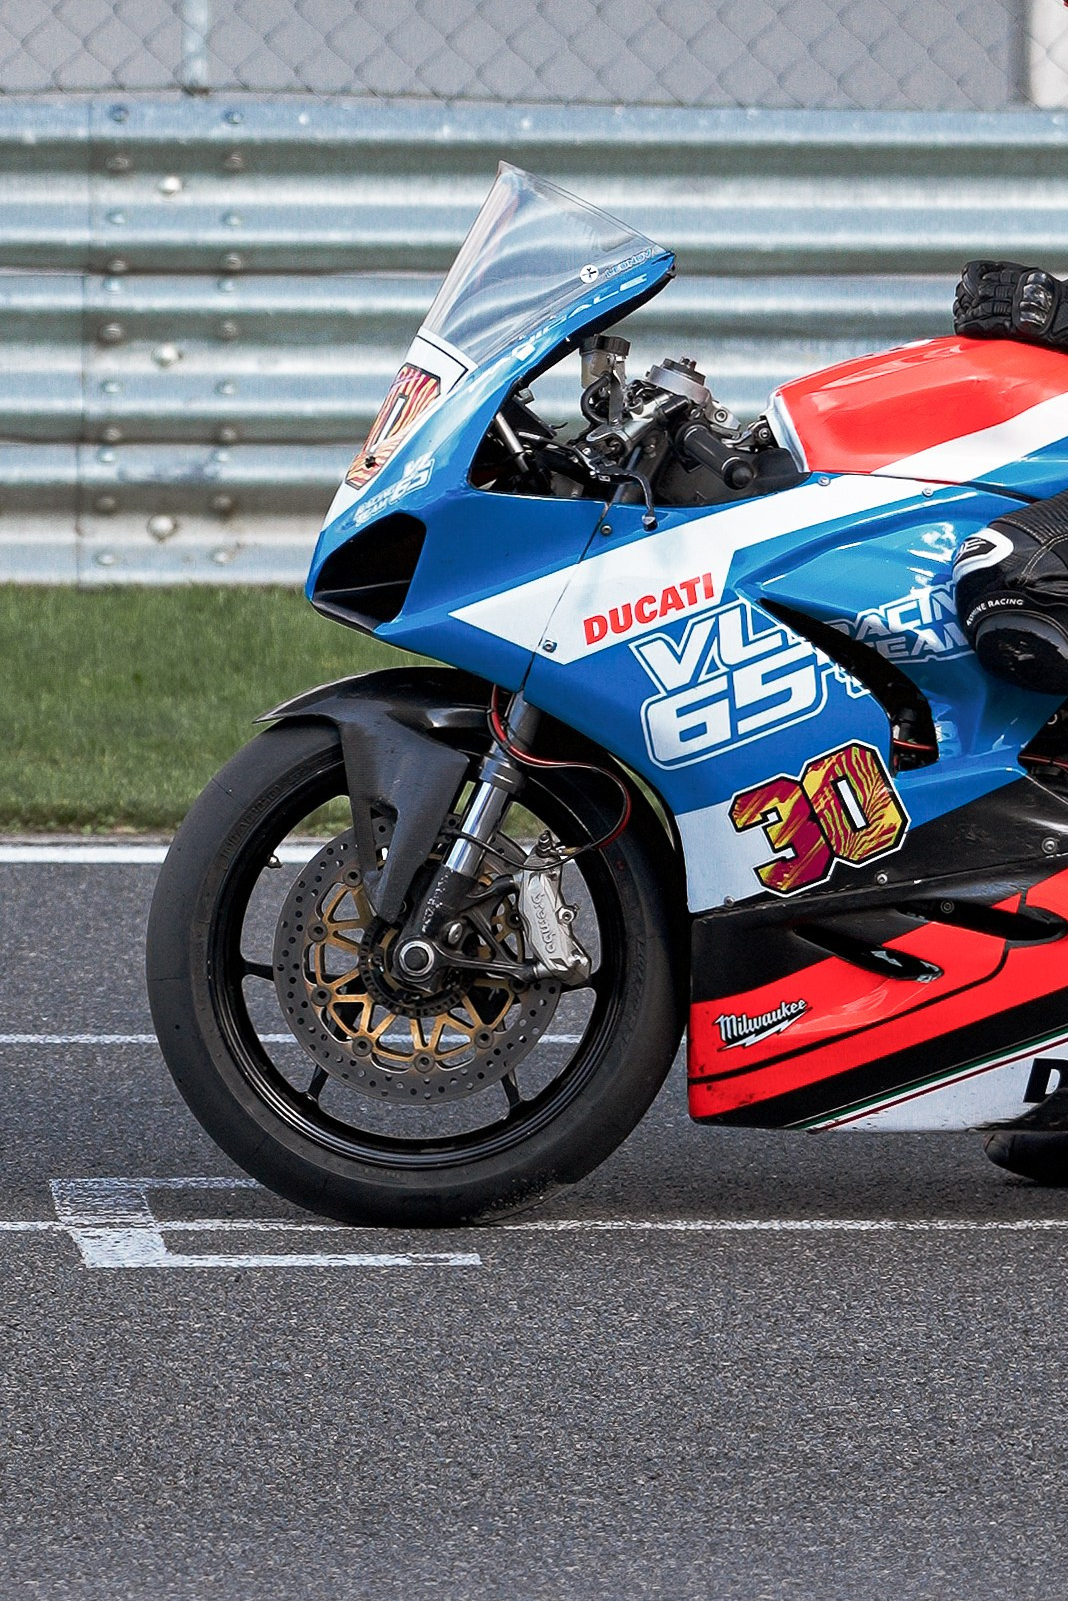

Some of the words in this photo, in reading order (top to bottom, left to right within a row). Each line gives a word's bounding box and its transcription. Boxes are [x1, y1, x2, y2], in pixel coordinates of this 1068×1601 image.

[583, 573, 715, 646] DUCATI
[987, 598, 1024, 608] RACING
[637, 605, 784, 691] VL
[646, 643, 817, 762] 65
[728, 739, 912, 897] 30
[531, 892, 556, 954] brembo
[714, 999, 808, 1042] Milwaukee
